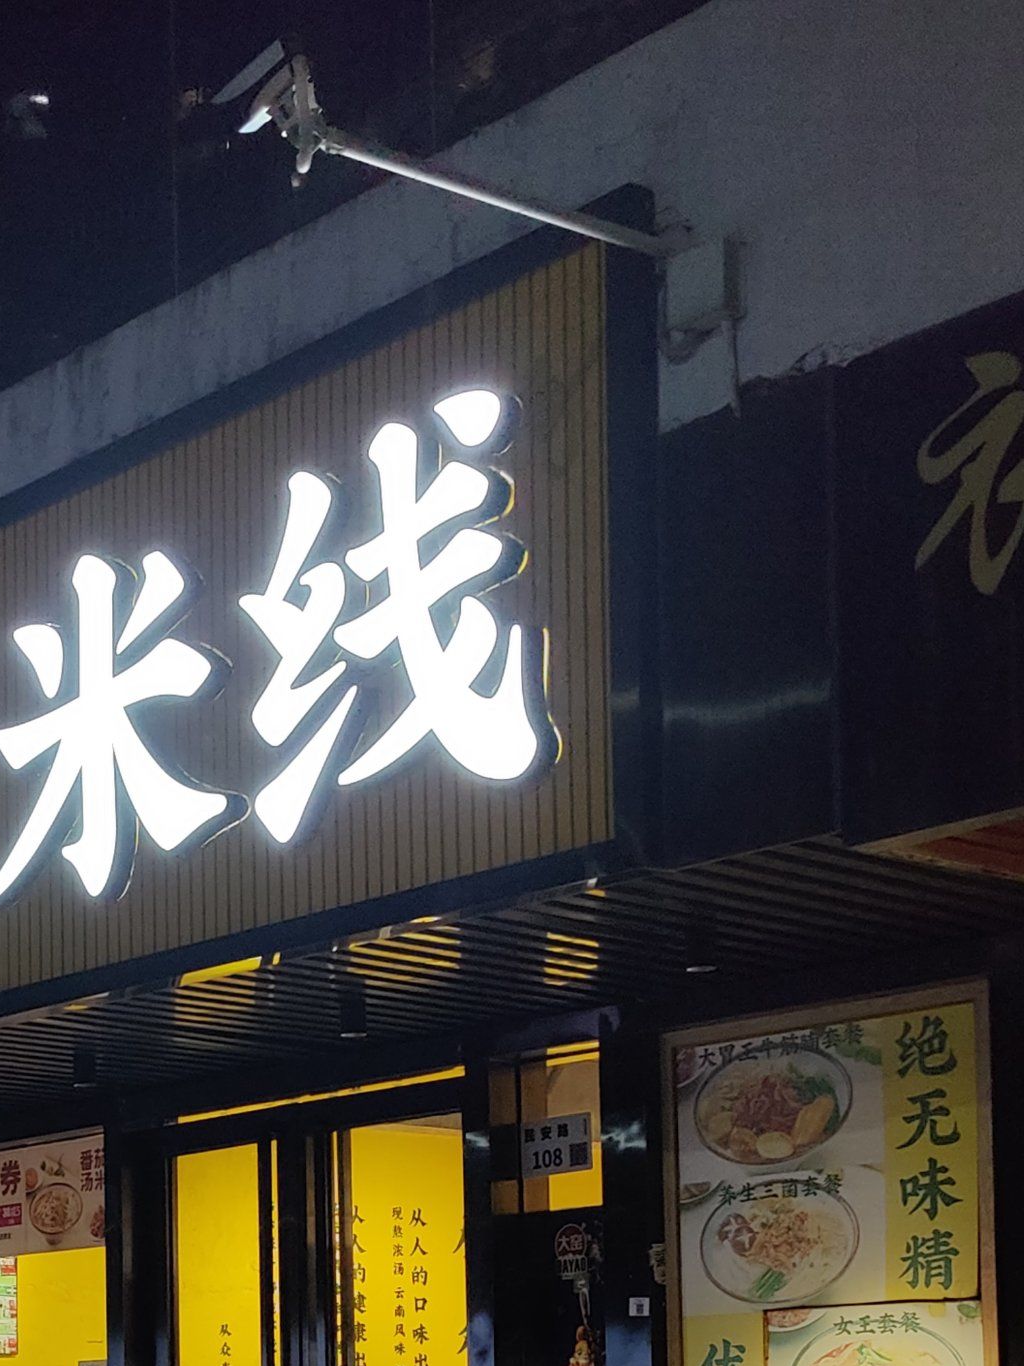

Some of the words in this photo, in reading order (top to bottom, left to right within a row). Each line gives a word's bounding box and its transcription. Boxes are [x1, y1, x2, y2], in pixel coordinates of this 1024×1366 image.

[532, 1148, 564, 1169] 108
[896, 1015, 964, 1291] 绝无味精
[833, 1312, 921, 1336] 女王套餐
